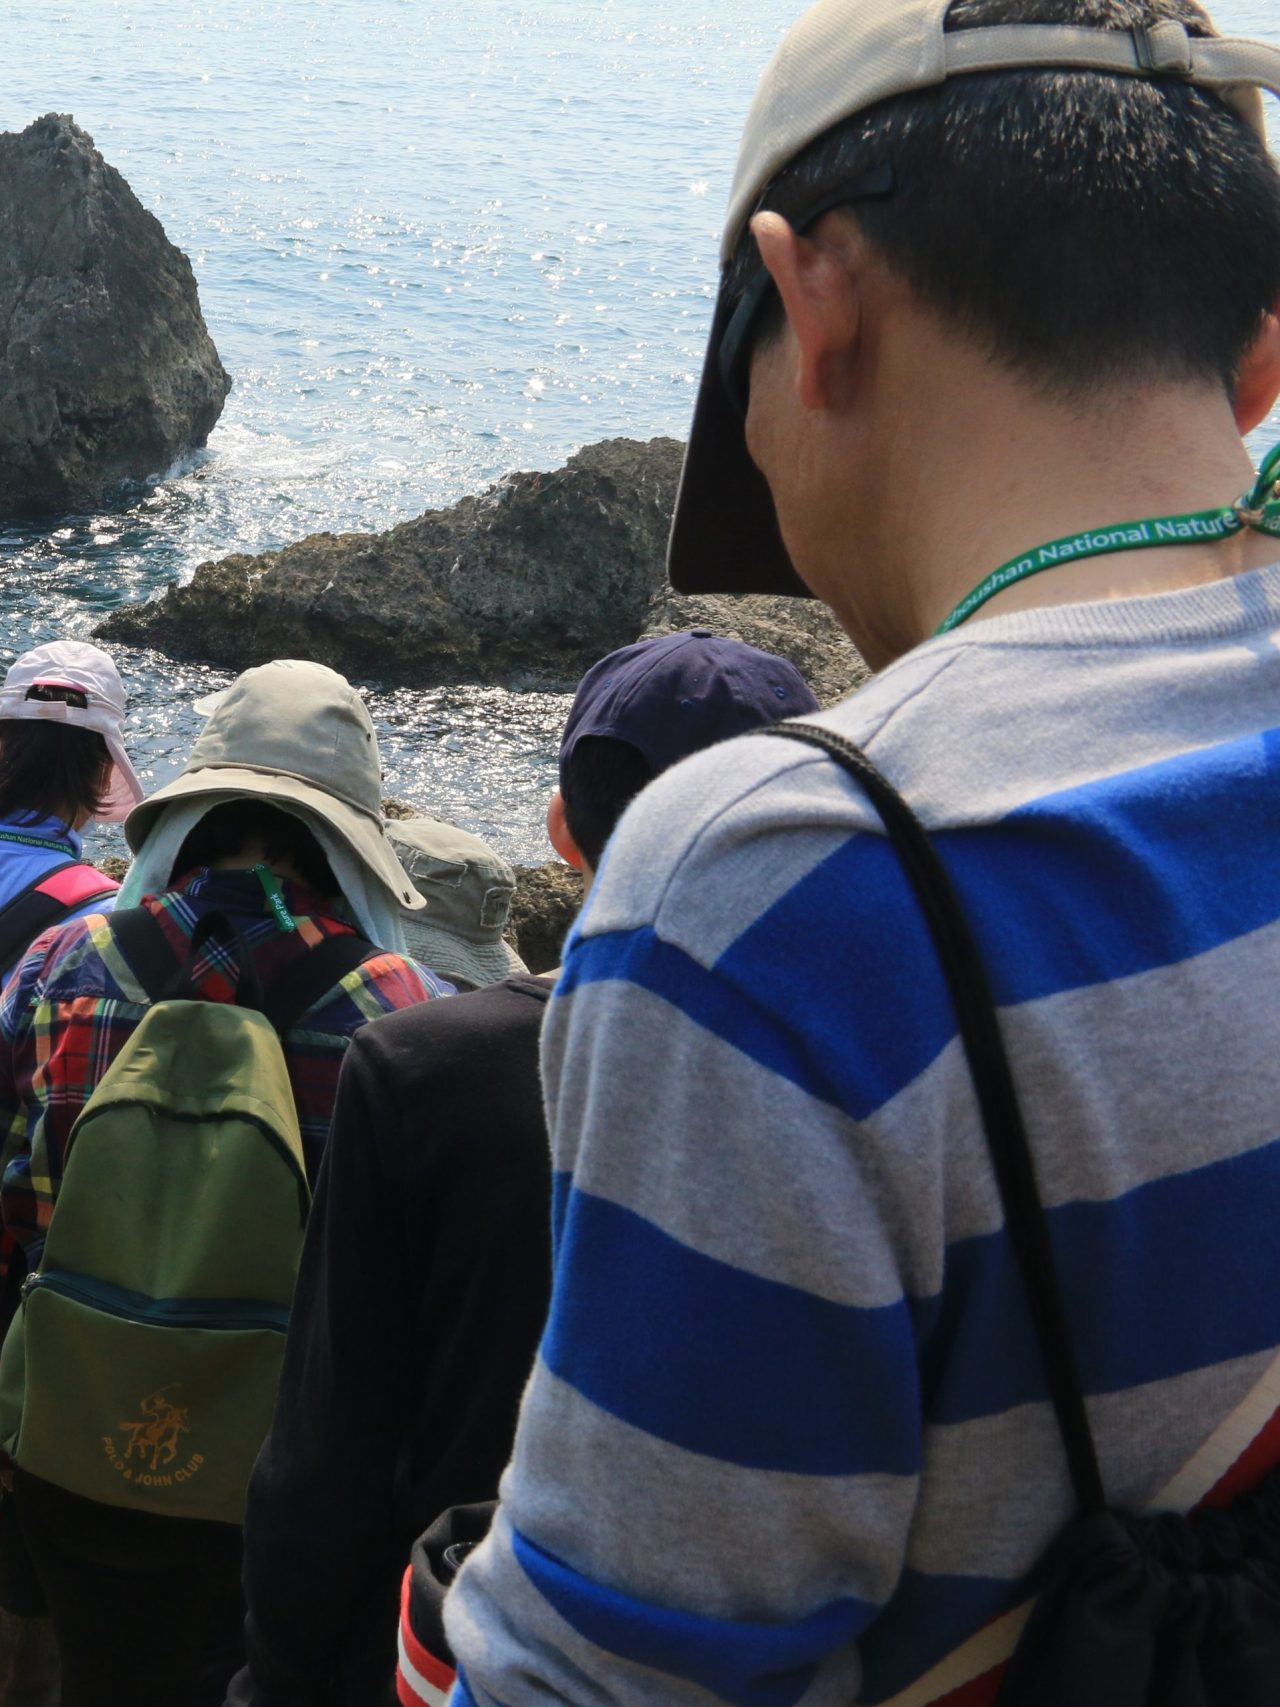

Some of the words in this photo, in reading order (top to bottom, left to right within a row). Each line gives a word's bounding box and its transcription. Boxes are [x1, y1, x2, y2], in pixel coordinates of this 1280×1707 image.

[942, 557, 1033, 631] Shoushan
[1038, 523, 1149, 563] National
[1154, 511, 1239, 538] Nature
[18, 835, 43, 846] National
[270, 893, 283, 910] Park
[102, 1435, 125, 1471] POLO
[135, 1473, 173, 1487] JOHN
[175, 1454, 204, 1482] CLUB
